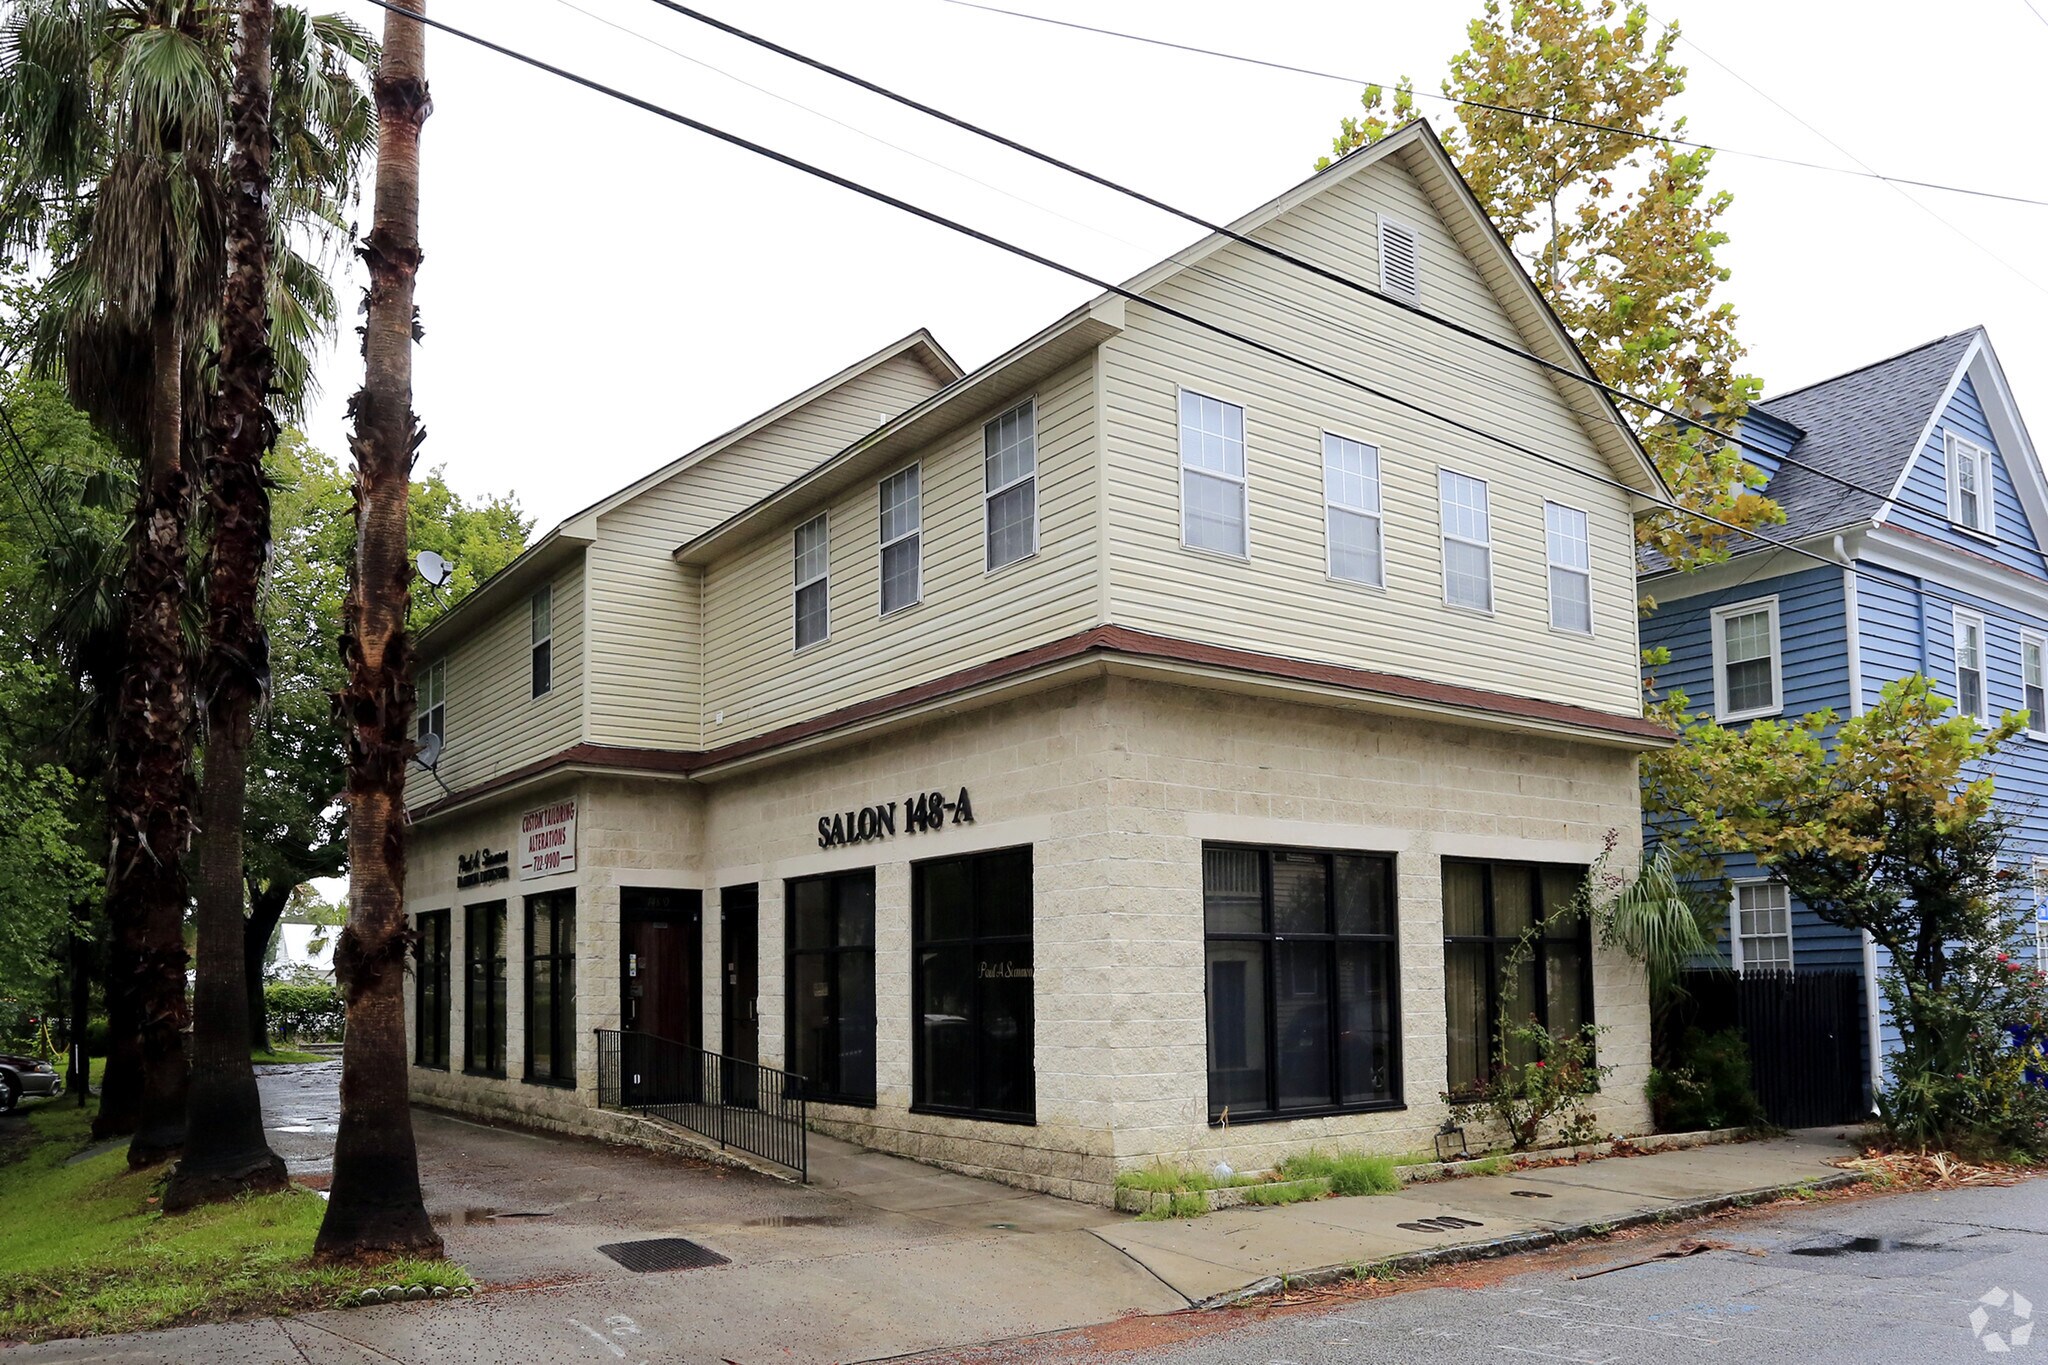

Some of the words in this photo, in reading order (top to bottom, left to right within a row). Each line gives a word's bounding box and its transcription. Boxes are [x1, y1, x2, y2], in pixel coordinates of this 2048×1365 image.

[522, 811, 544, 833] CUSTOM
[545, 801, 575, 826] TAILORING
[818, 802, 896, 848] SALON
[904, 787, 974, 833] 148-A
[529, 827, 566, 853] ALTERATIONS
